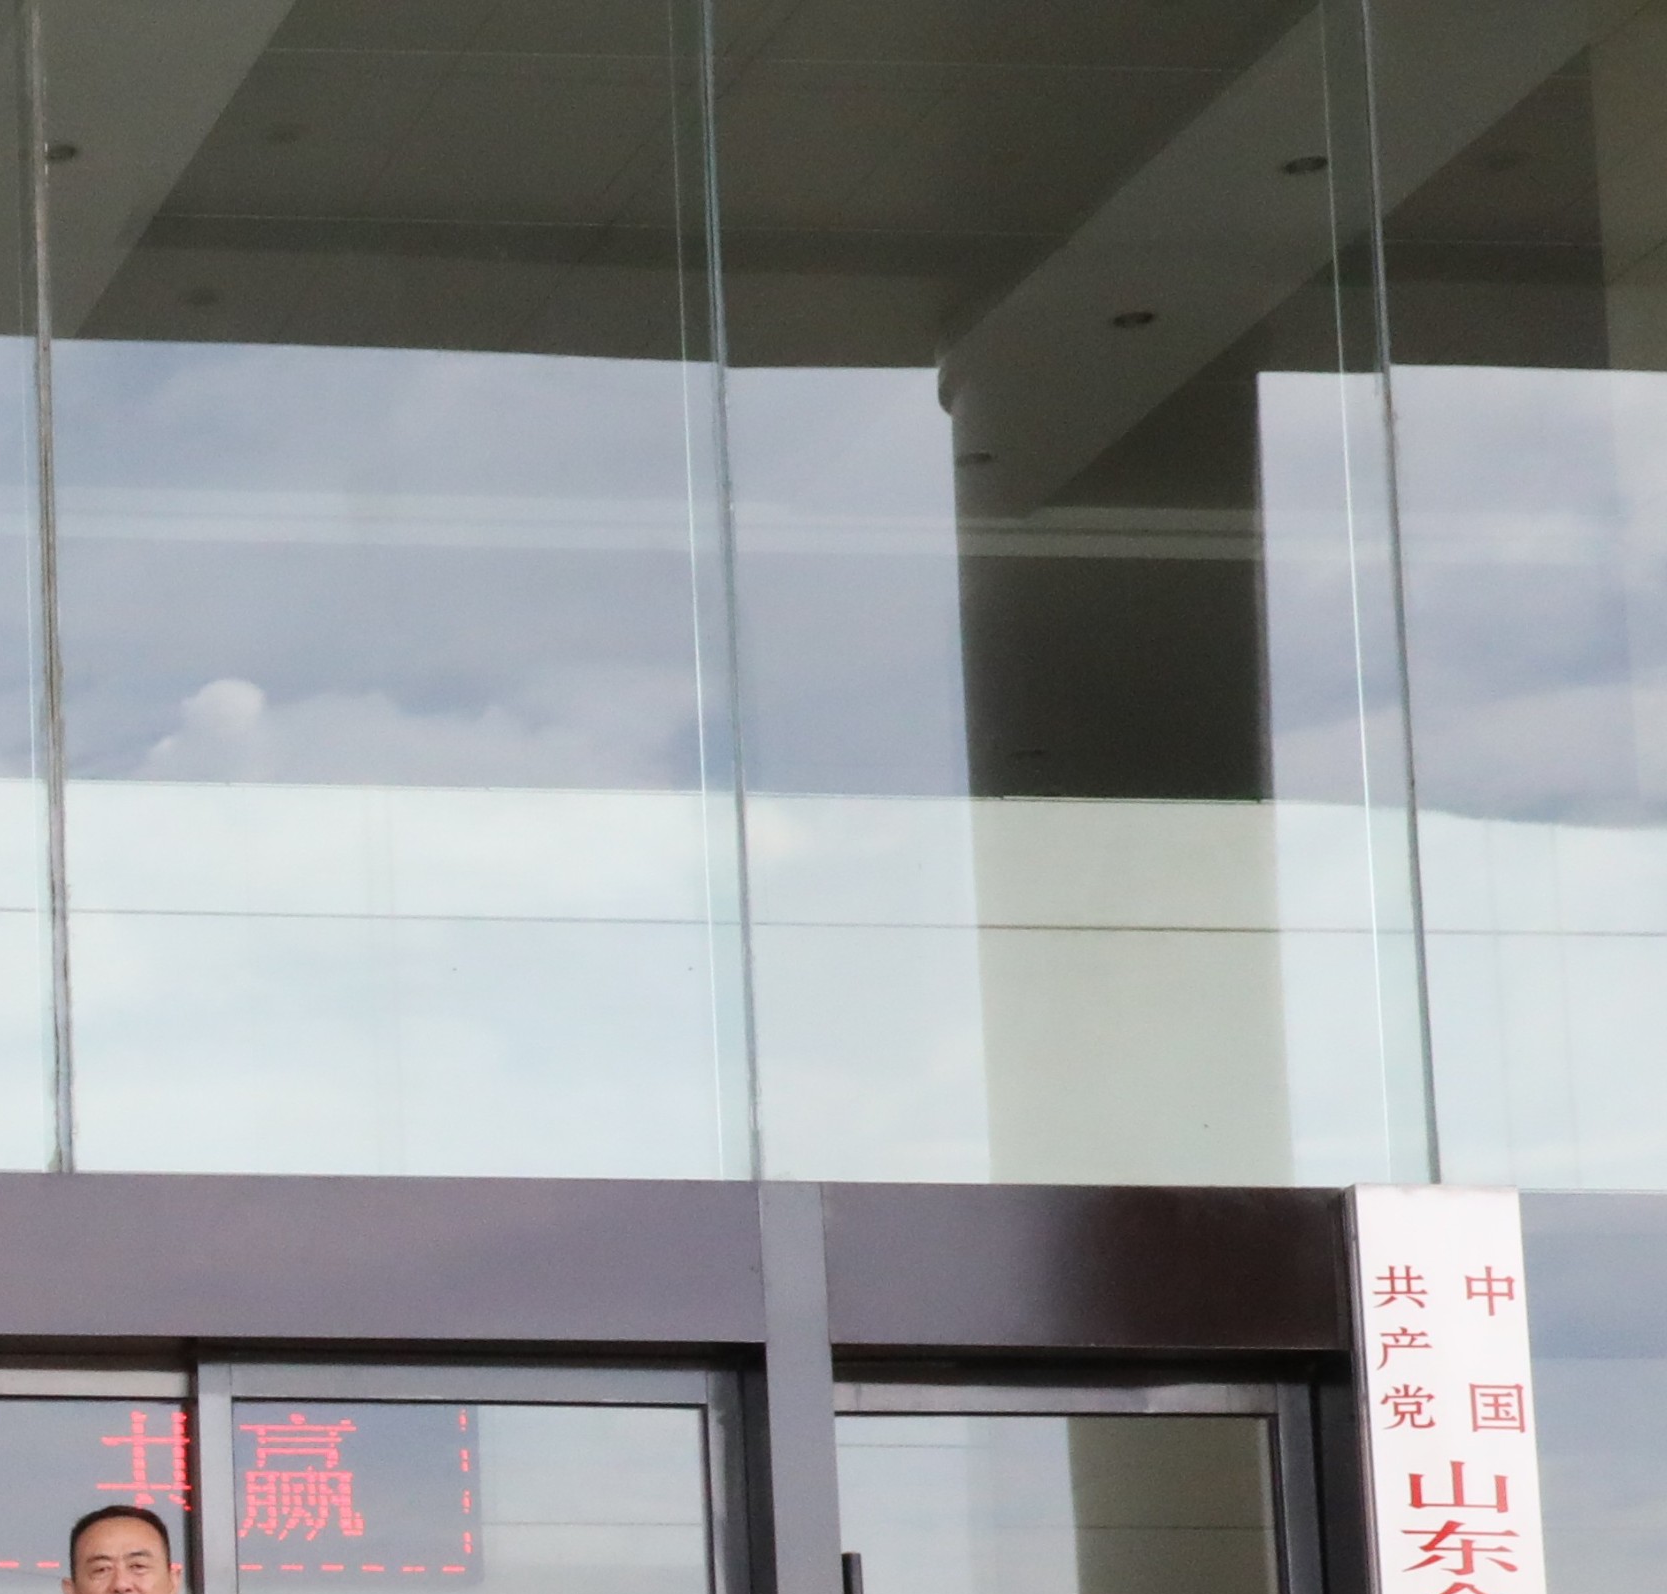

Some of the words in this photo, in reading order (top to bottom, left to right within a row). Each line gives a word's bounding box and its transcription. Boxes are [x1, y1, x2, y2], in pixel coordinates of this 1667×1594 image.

[1372, 1265, 1436, 1431] 共产党
[1464, 1265, 1527, 1434] 中国
[96, 1411, 365, 1541] 共赢
